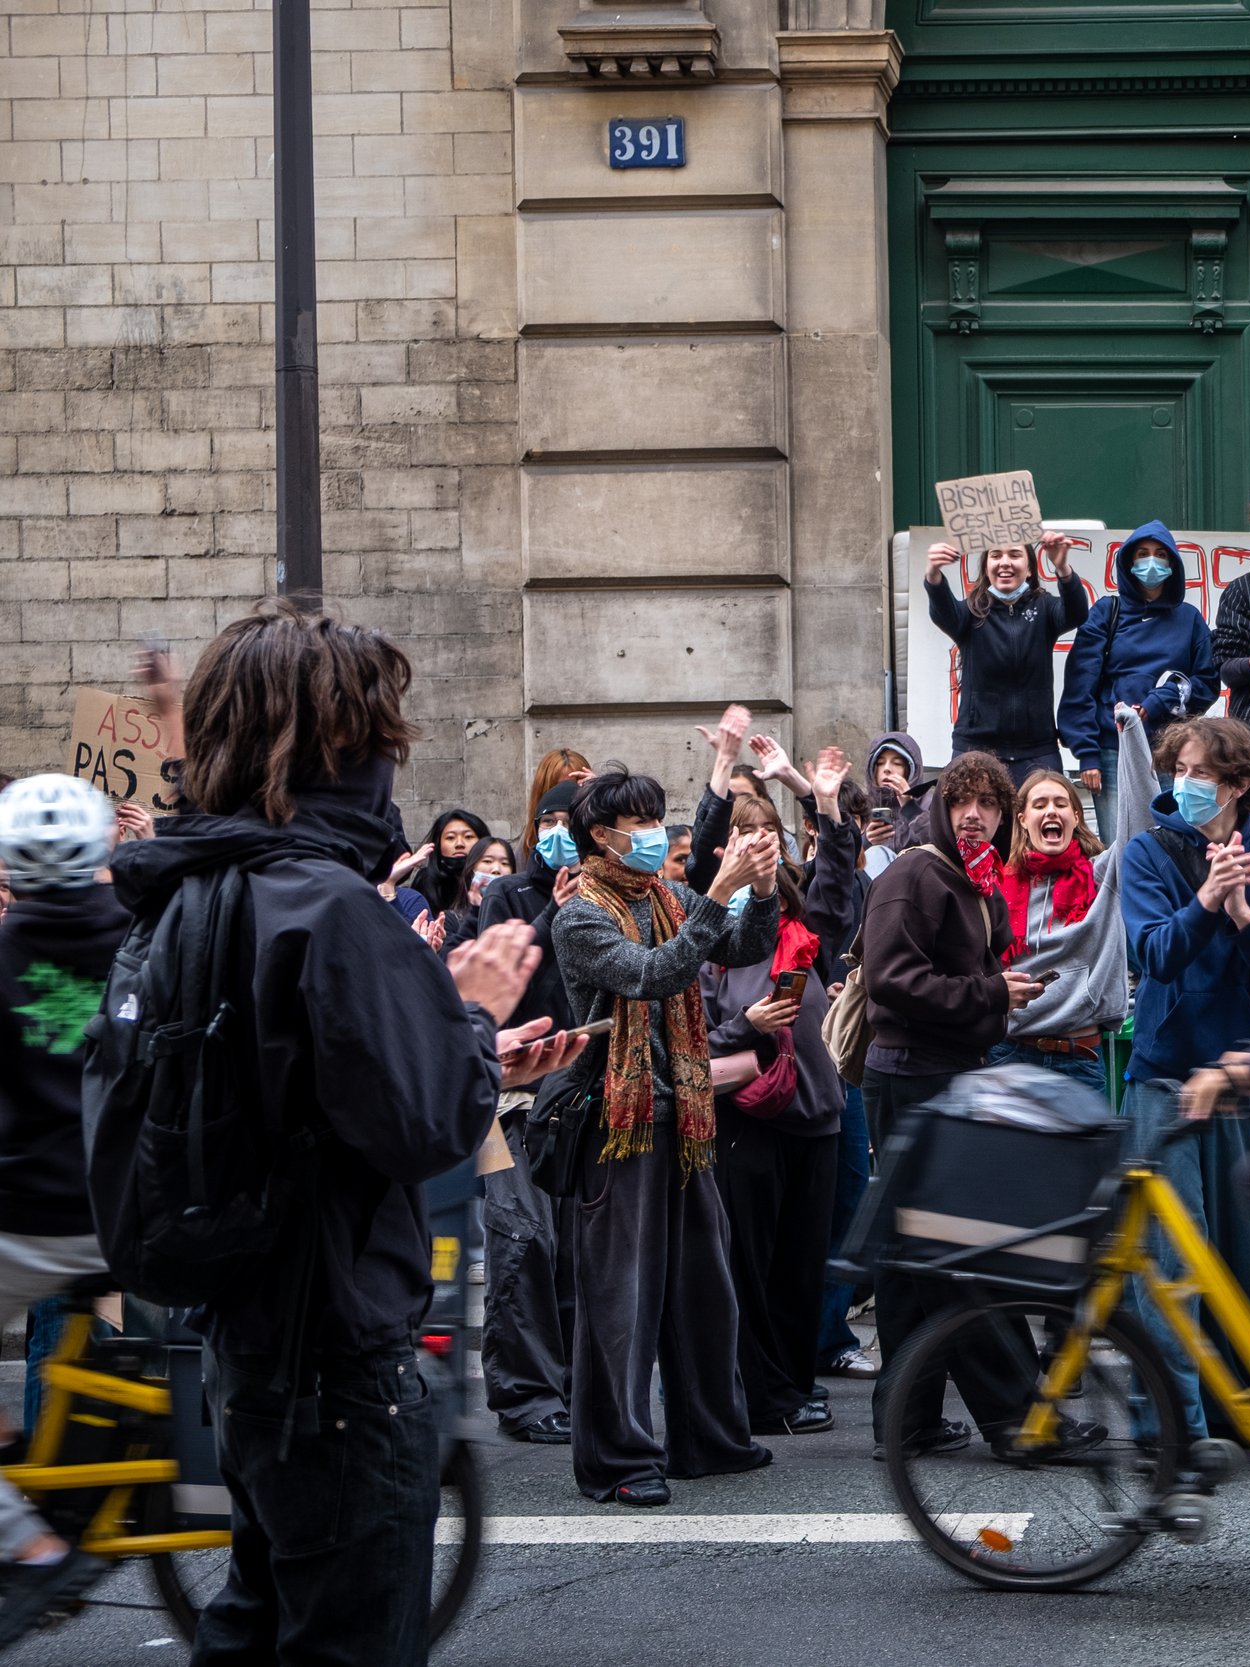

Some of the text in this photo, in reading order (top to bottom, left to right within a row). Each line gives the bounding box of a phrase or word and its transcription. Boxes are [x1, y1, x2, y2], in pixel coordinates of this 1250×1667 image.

[614, 125, 678, 160] 391
[999, 504, 1033, 522] LES
[74, 742, 137, 800] PAS
